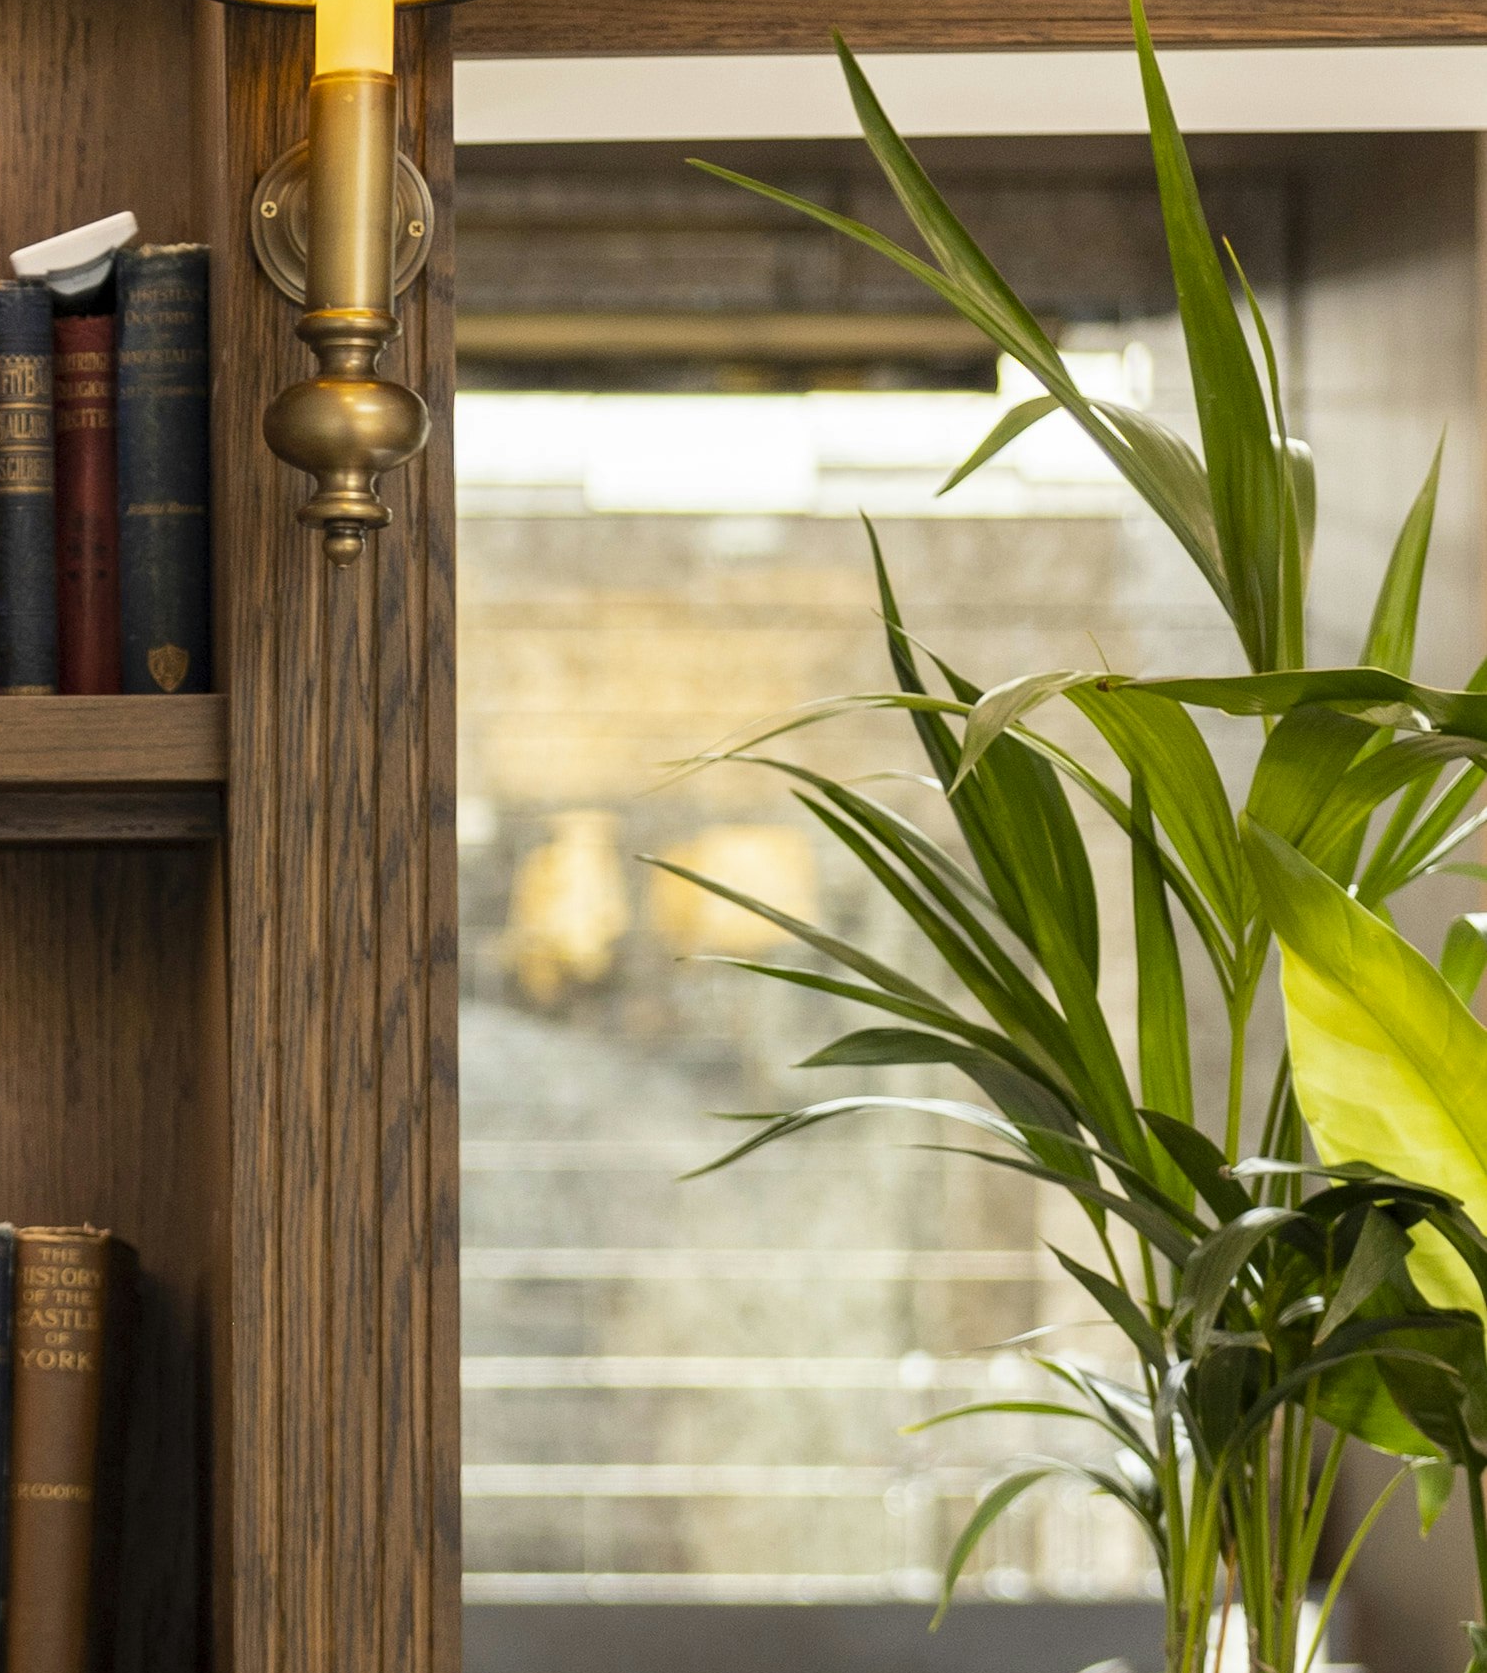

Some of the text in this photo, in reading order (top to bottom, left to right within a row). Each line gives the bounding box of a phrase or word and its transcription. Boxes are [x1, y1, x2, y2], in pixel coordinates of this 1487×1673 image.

[37, 1245, 82, 1264] THE
[20, 1264, 101, 1288] HISTORY
[21, 1288, 93, 1305] OF THE
[44, 1330, 72, 1346] OF
[18, 1347, 96, 1372] YORK
